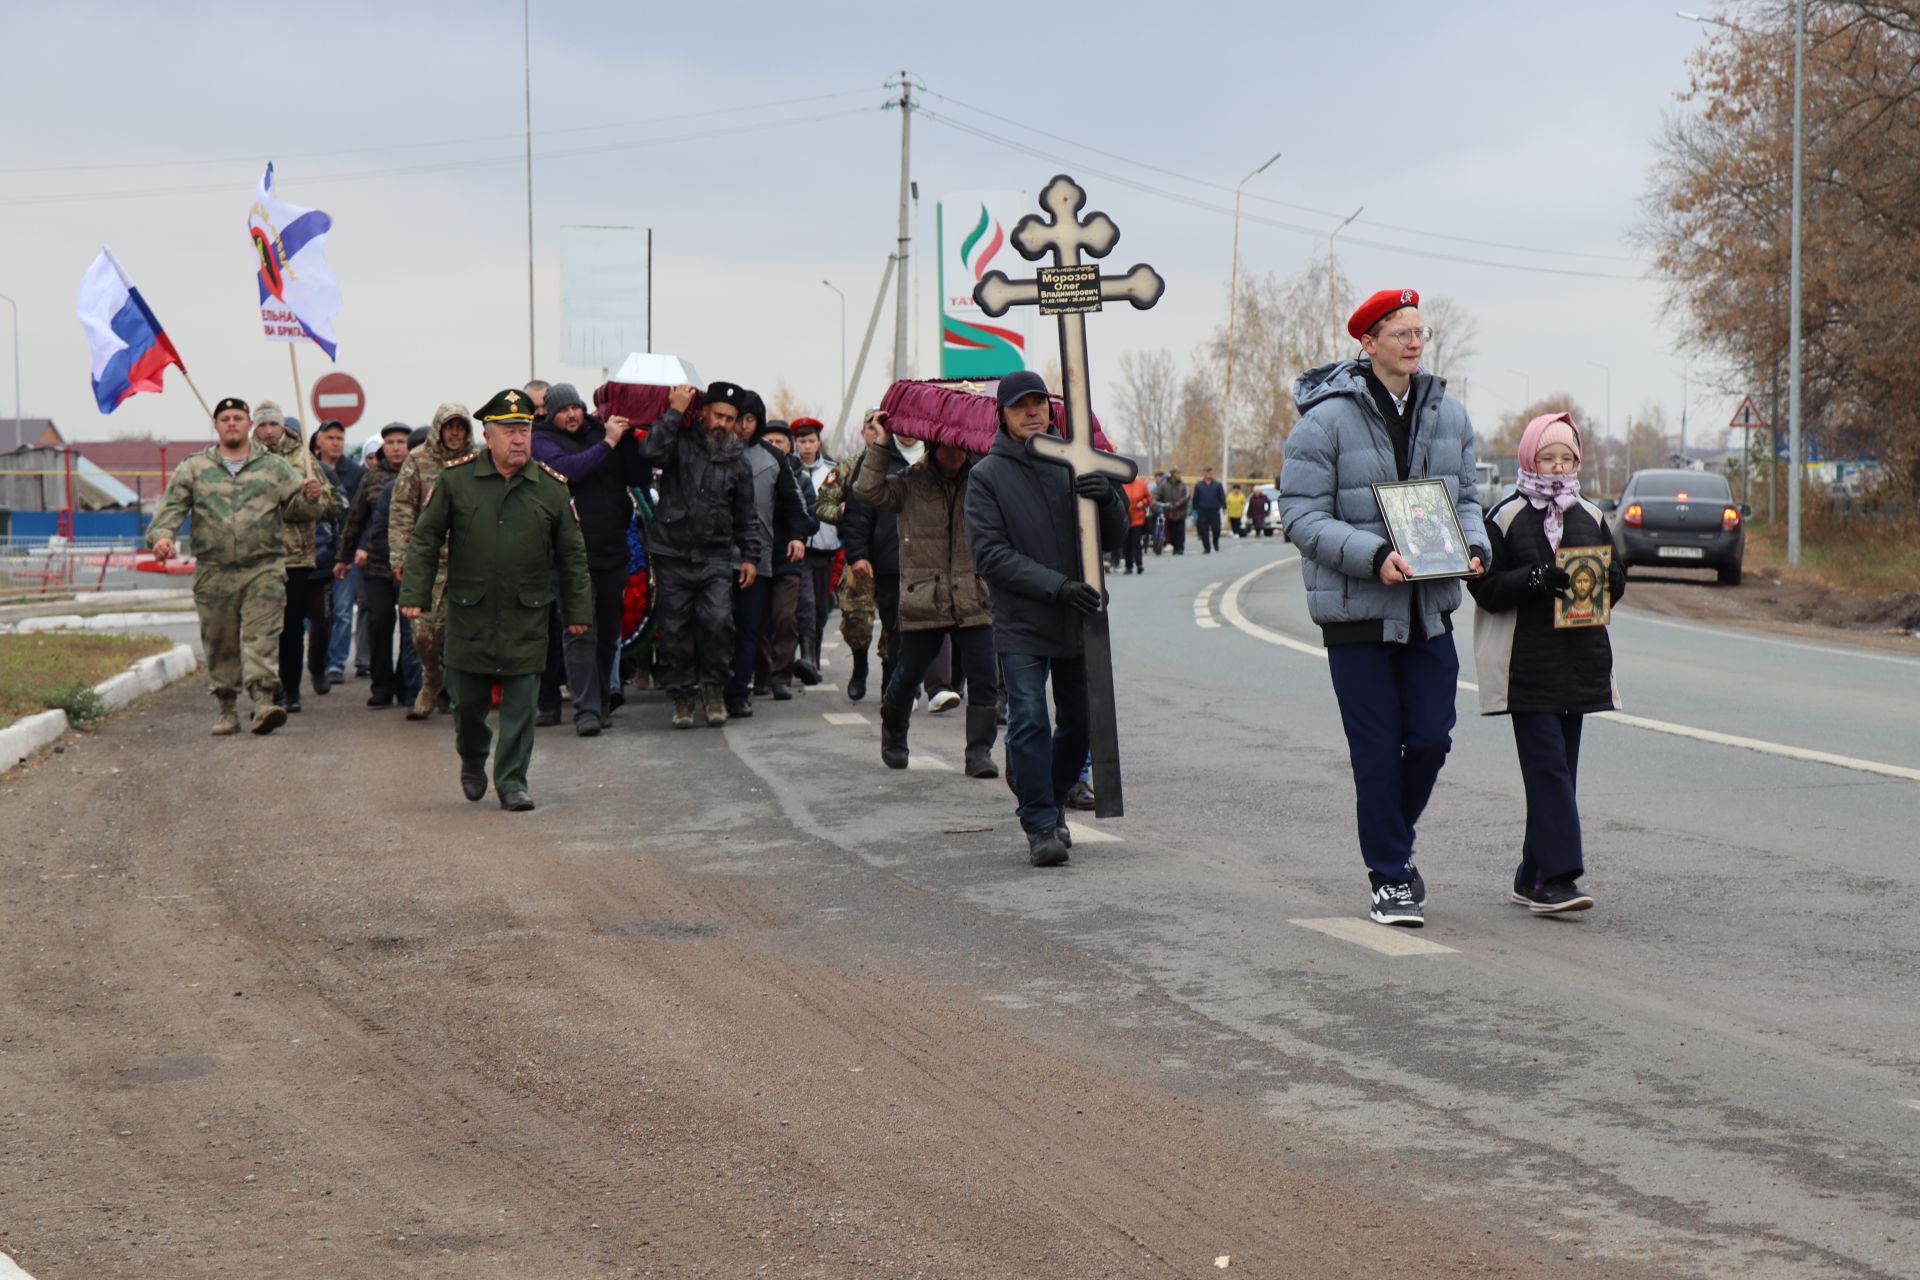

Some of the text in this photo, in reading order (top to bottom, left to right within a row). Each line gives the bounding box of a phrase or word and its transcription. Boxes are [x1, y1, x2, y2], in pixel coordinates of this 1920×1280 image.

[1042, 273, 1096, 283] Морозов
[1054, 283, 1080, 291] Олег
[1041, 289, 1098, 299] Владимирович
[261, 309, 297, 323] ЕЛЬНА
